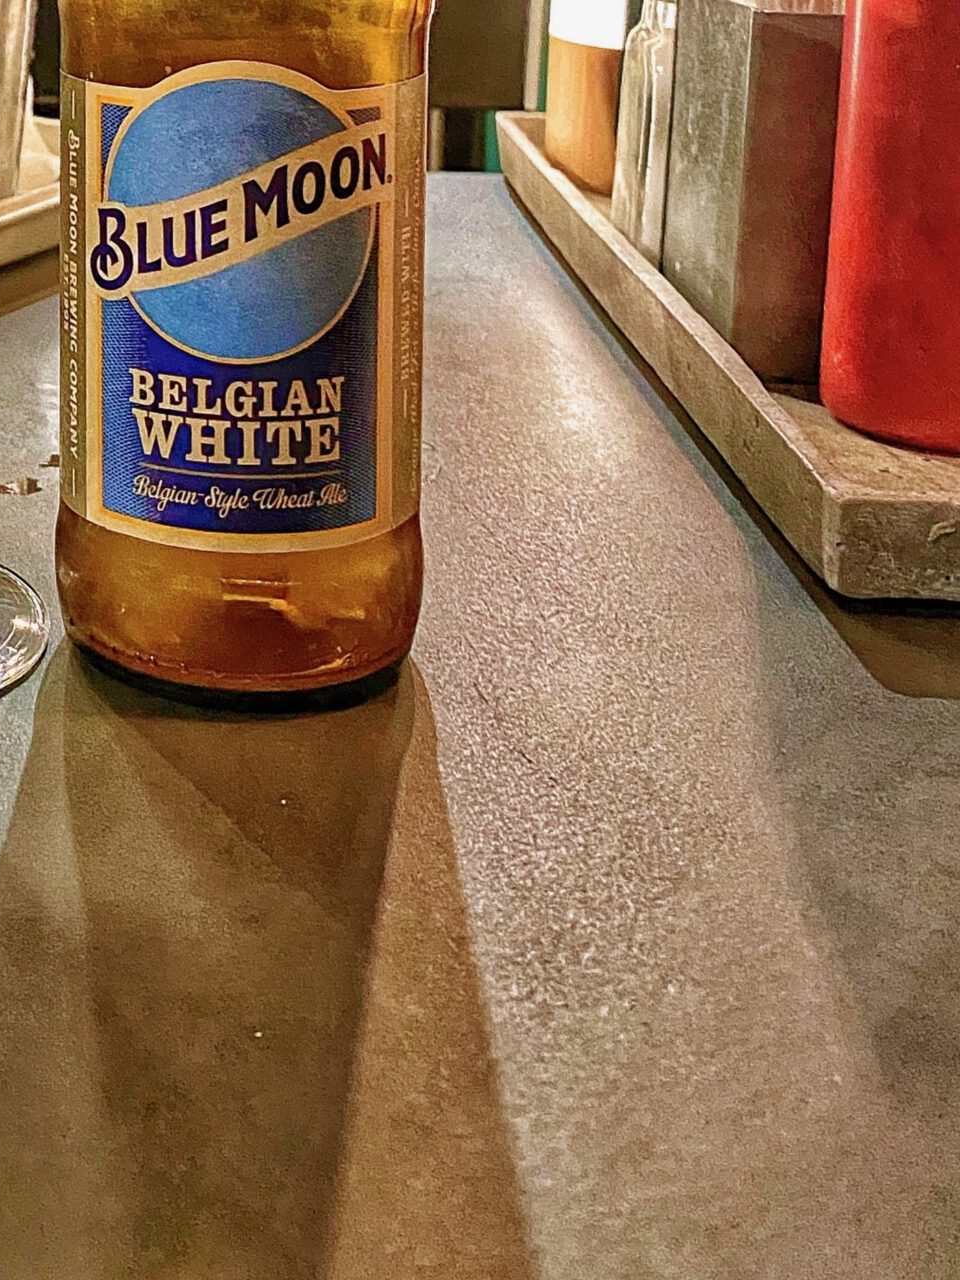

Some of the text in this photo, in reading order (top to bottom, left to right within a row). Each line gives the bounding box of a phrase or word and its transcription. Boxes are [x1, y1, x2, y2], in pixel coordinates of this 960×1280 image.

[90, 198, 231, 291] BLUE
[400, 225, 412, 282] WITH
[67, 128, 81, 460] BLUE MOON BREWING COMPANY
[128, 367, 345, 419] BELGIAN
[131, 408, 341, 466] WHITE
[133, 473, 348, 519] Belgian-Style Wheat Ale
